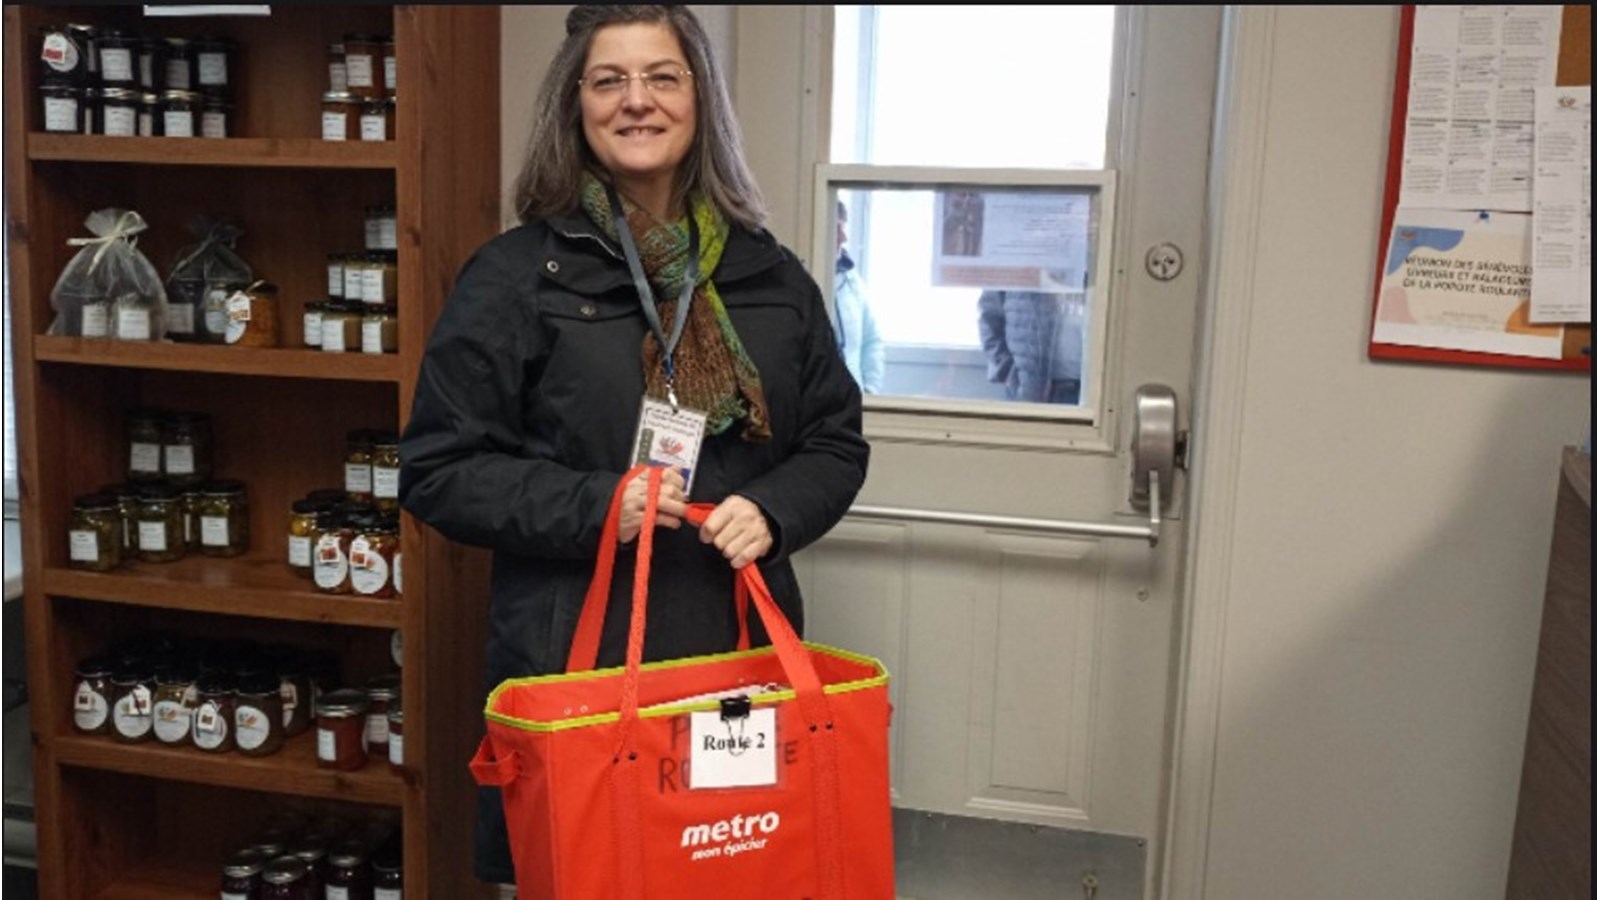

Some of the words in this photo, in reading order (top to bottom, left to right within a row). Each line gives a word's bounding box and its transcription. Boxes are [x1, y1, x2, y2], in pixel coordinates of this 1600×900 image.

[1455, 259, 1473, 270] DES
[1402, 277, 1415, 287] DE
[1420, 279, 1431, 289] LA
[1457, 271, 1469, 281] ET
[703, 735, 751, 750] Route
[756, 733, 765, 749] 2
[681, 811, 779, 847] metro
[691, 847, 721, 861] mon
[723, 838, 768, 857] épicier
